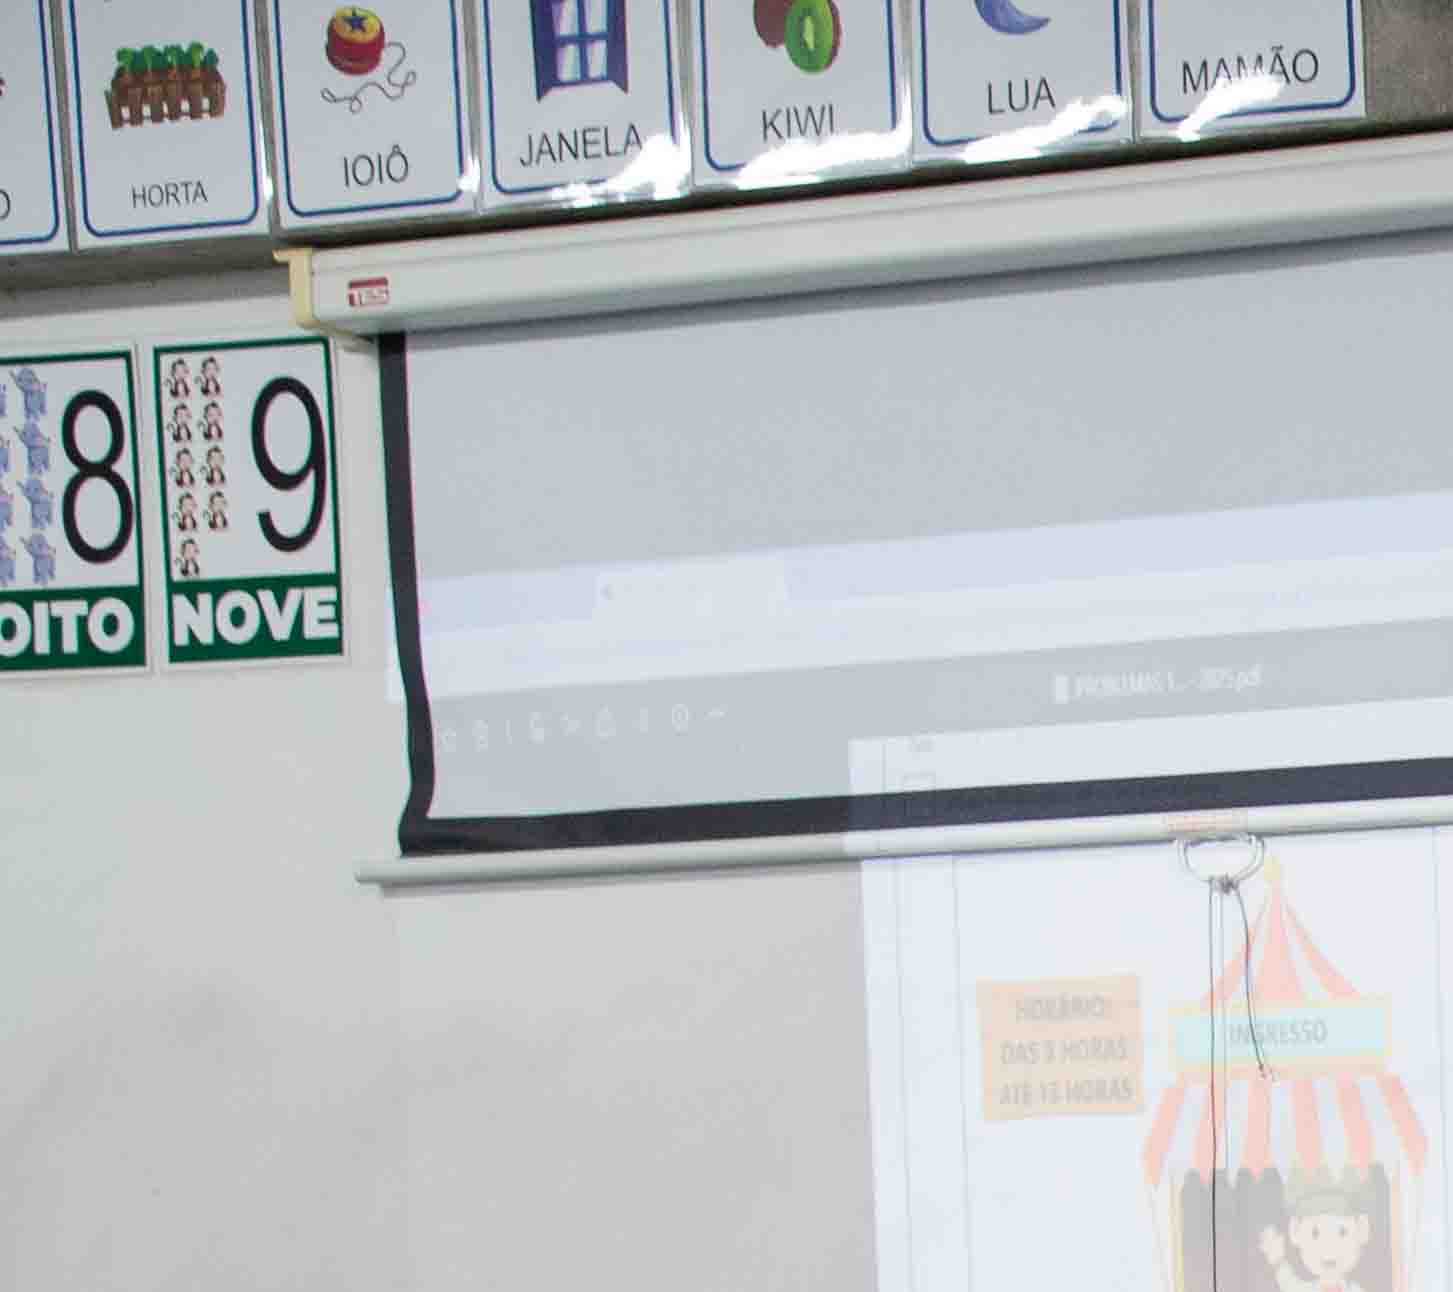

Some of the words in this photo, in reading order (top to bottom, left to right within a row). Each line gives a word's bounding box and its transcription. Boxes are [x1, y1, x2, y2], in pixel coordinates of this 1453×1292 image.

[987, 77, 1056, 116] LUA
[761, 103, 836, 142] KIWI
[343, 147, 410, 188] IOIÔ
[520, 122, 644, 169] JANELA
[131, 182, 209, 210] HORTA
[61, 389, 134, 563] 8
[251, 376, 327, 552] 9
[171, 587, 340, 648] NOVE
